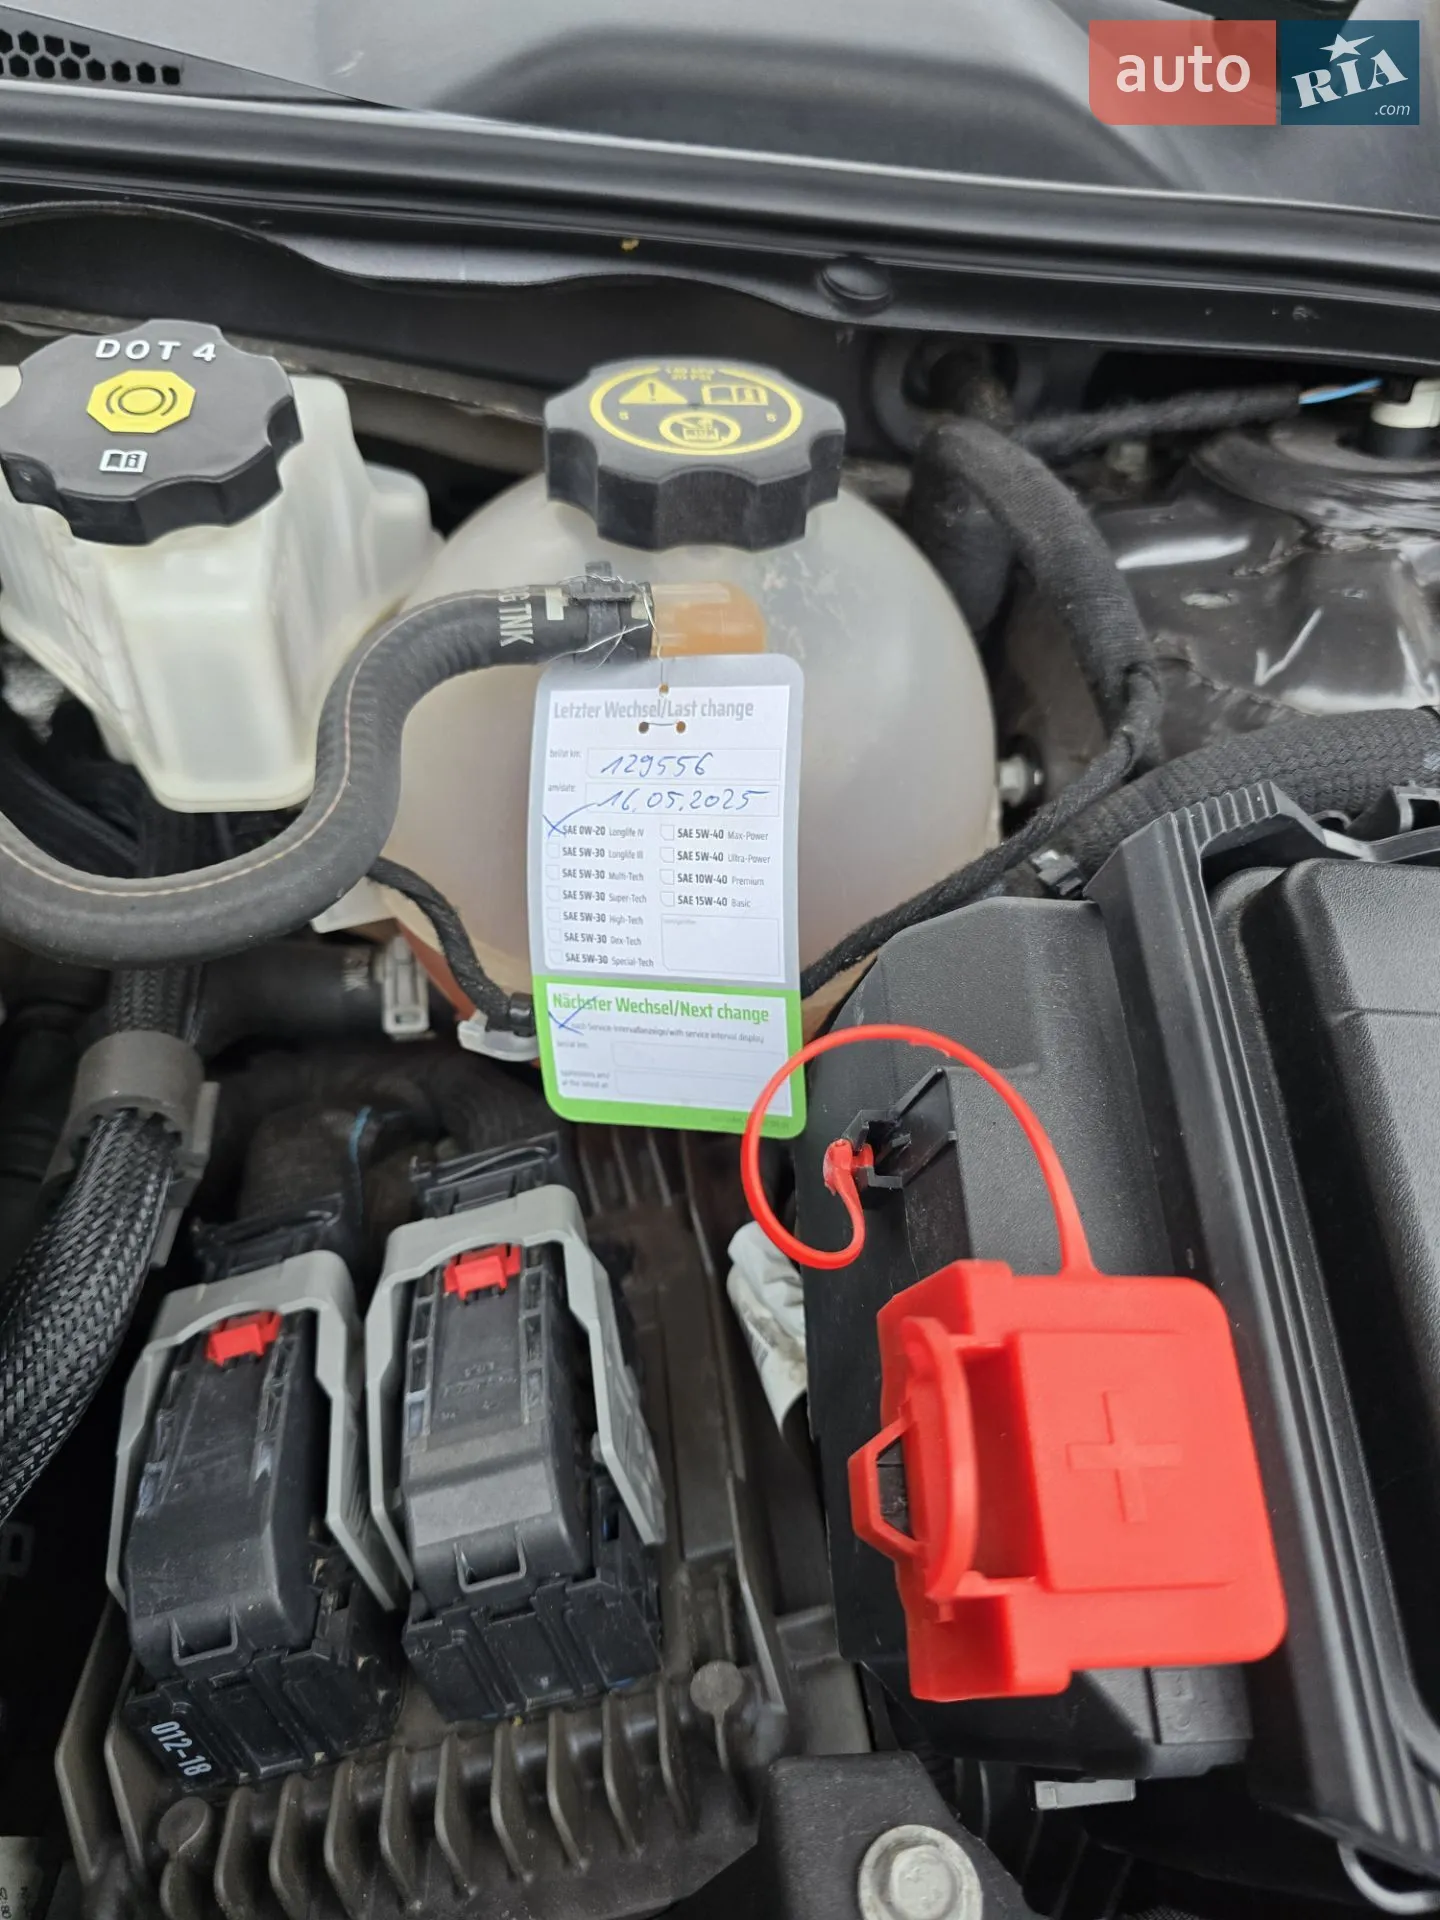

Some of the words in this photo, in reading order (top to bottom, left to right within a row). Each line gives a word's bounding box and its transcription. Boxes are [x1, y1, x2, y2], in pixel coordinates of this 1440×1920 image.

[95, 339, 181, 361] DOT
[192, 342, 217, 362] 4
[554, 701, 602, 719] Letzter
[604, 700, 697, 719] Wechsel/Last
[701, 699, 754, 721] change
[600, 752, 714, 777] 129556
[597, 787, 770, 812] 16.05.2025
[563, 826, 577, 835] SAE
[580, 826, 605, 836] 0W-20
[609, 828, 635, 838] Longlife
[678, 828, 693, 839] SAE
[696, 828, 724, 840] 5W-40
[728, 831, 768, 840] Max-Power
[562, 847, 576, 856] SAE
[579, 848, 605, 858] 5W-30
[678, 851, 693, 861] SAE
[695, 852, 723, 862] 5W-40
[728, 854, 770, 864] Ultra-Power
[562, 868, 576, 878] SAE
[579, 869, 605, 880] 5W-30
[608, 871, 644, 881] Multi-Tech
[678, 873, 693, 883] SAE
[696, 874, 727, 884] 10W-40
[732, 876, 764, 886] Premium
[563, 890, 577, 900] SAE
[579, 890, 605, 901] 5W-30
[609, 893, 646, 903] Super-Tech
[678, 895, 693, 905] SAE
[696, 896, 727, 906] 15W-40
[731, 898, 751, 908] Basic
[563, 912, 577, 921] SAE
[580, 912, 606, 923] 5W-30
[564, 932, 578, 942] SAE
[581, 933, 606, 944] 5W-30
[566, 952, 581, 962] SAE
[582, 954, 608, 964] 5W-30
[553, 993, 612, 1011] Nächster
[616, 997, 713, 1018] Wechsel/Next
[717, 1003, 769, 1025] change
[151, 1721, 212, 1776] 012-18
